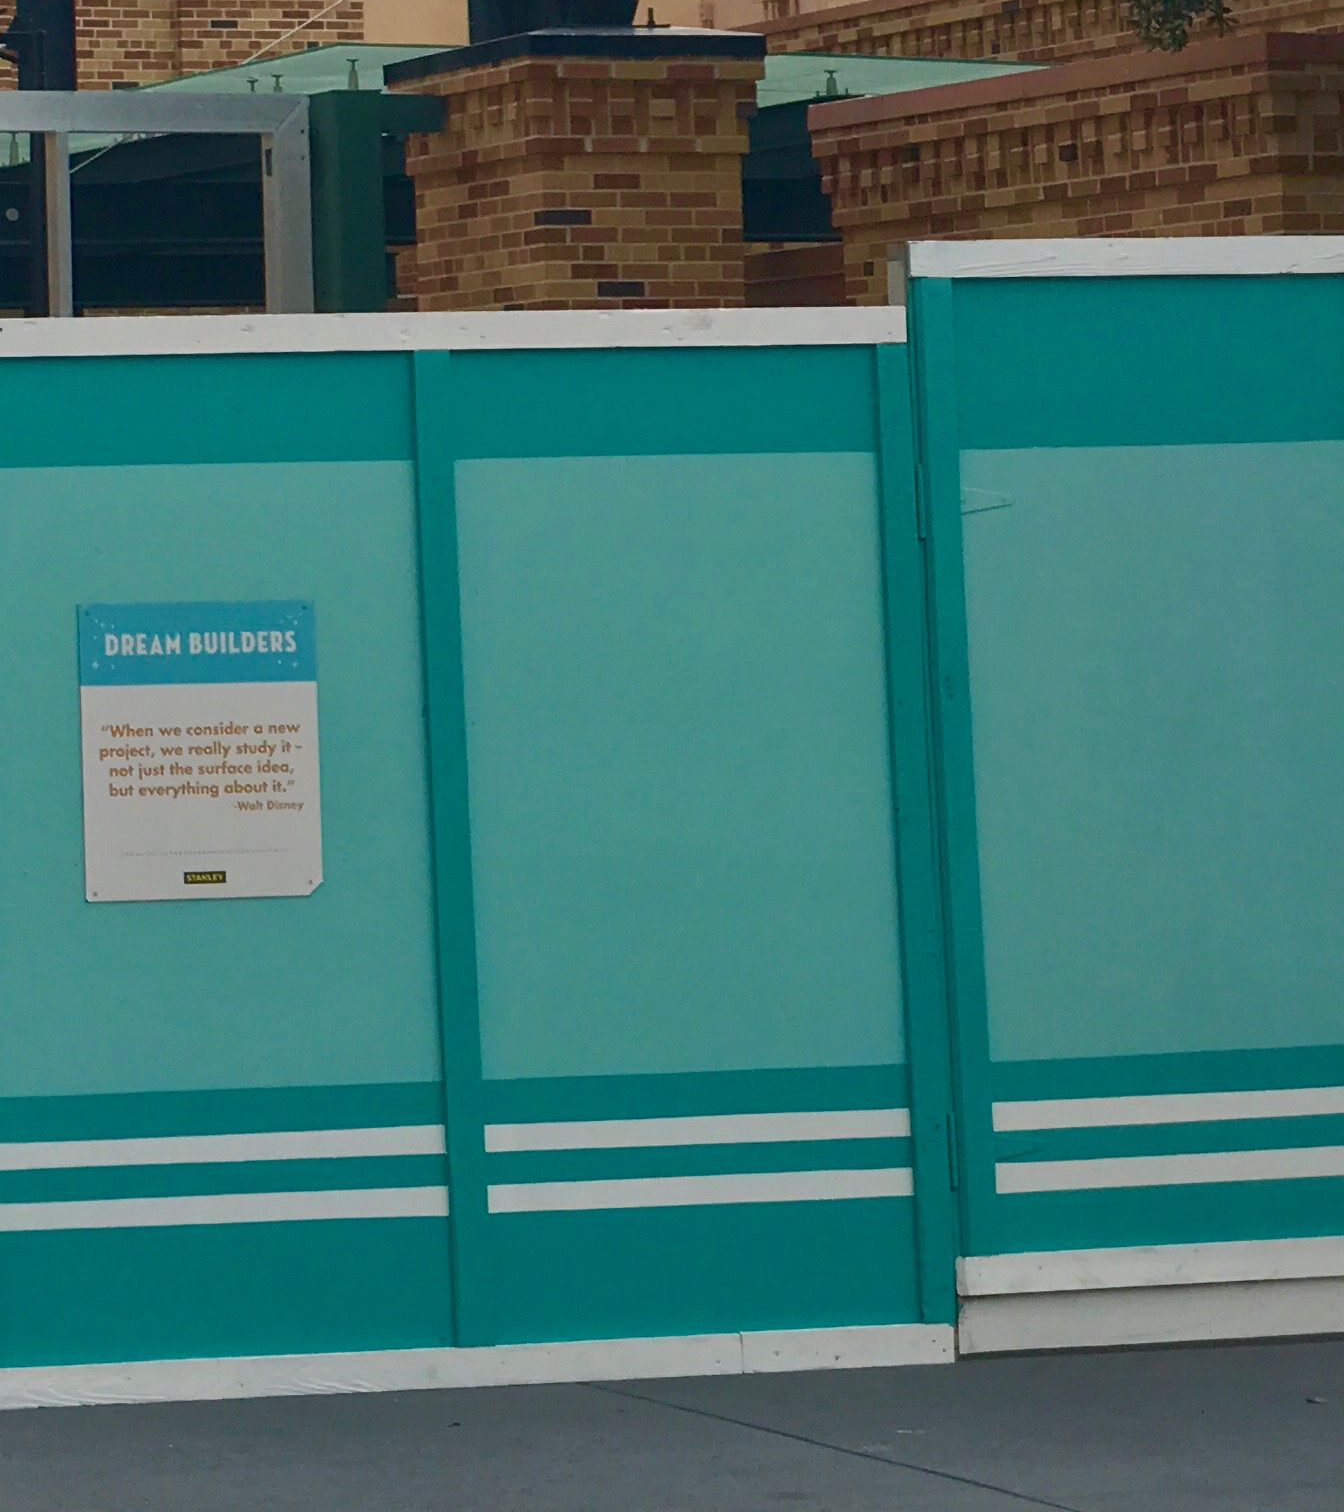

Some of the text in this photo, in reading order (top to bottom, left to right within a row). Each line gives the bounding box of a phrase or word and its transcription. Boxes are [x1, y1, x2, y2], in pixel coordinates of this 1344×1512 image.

[105, 630, 297, 656] DREAM BUILDERS
[159, 727, 182, 737] we
[186, 721, 249, 737] consider
[253, 725, 263, 735] a
[268, 724, 300, 734] new
[99, 744, 155, 761] project,
[160, 746, 183, 757] we
[188, 740, 231, 758] really
[236, 740, 276, 757] study
[280, 739, 292, 753] it
[109, 759, 295, 780] not just the surface idea,
[109, 782, 134, 797] but
[138, 781, 219, 798] everything
[224, 779, 269, 794] about
[266, 800, 304, 812] Disney
